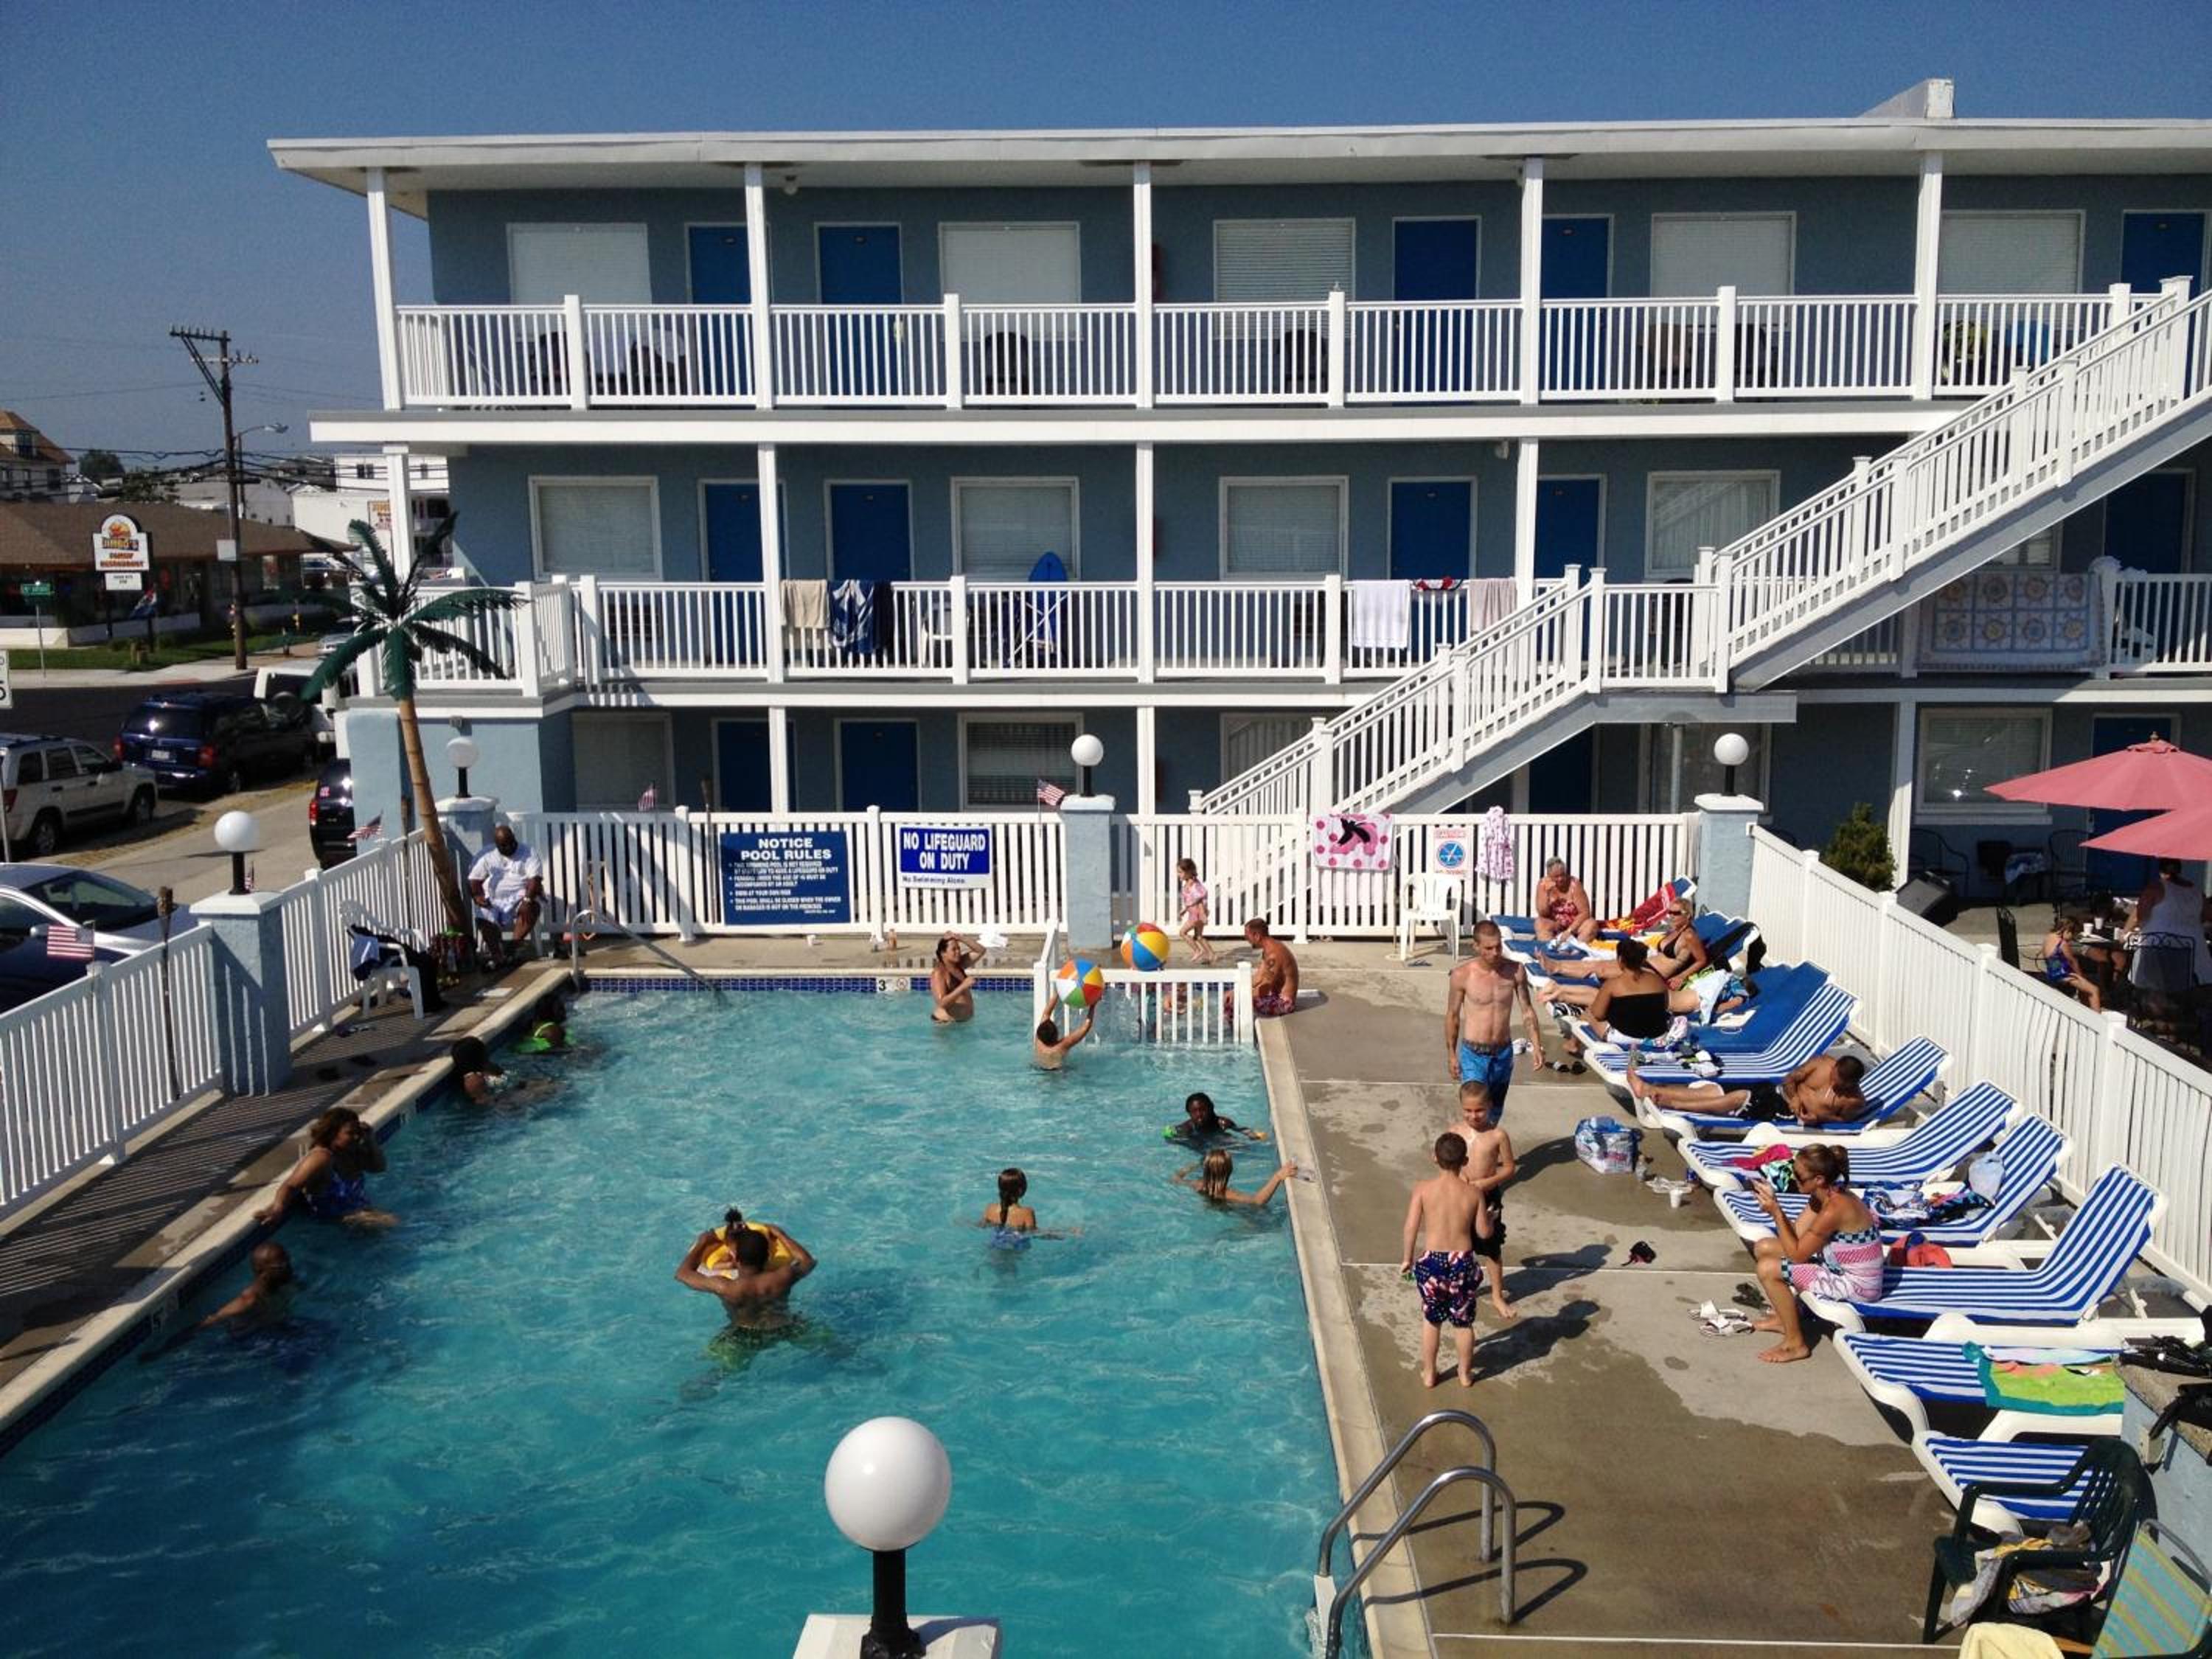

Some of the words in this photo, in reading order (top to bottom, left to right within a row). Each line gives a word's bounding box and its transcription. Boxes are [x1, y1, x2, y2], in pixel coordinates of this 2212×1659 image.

[758, 838, 813, 849] NOTICE
[903, 832, 919, 849] NO
[924, 832, 986, 852] LIFEGUARD
[741, 850, 780, 860] POOL
[784, 849, 832, 860] RULES
[919, 852, 935, 869] ON
[940, 852, 970, 870] DUTY
[878, 979, 886, 991] 3
